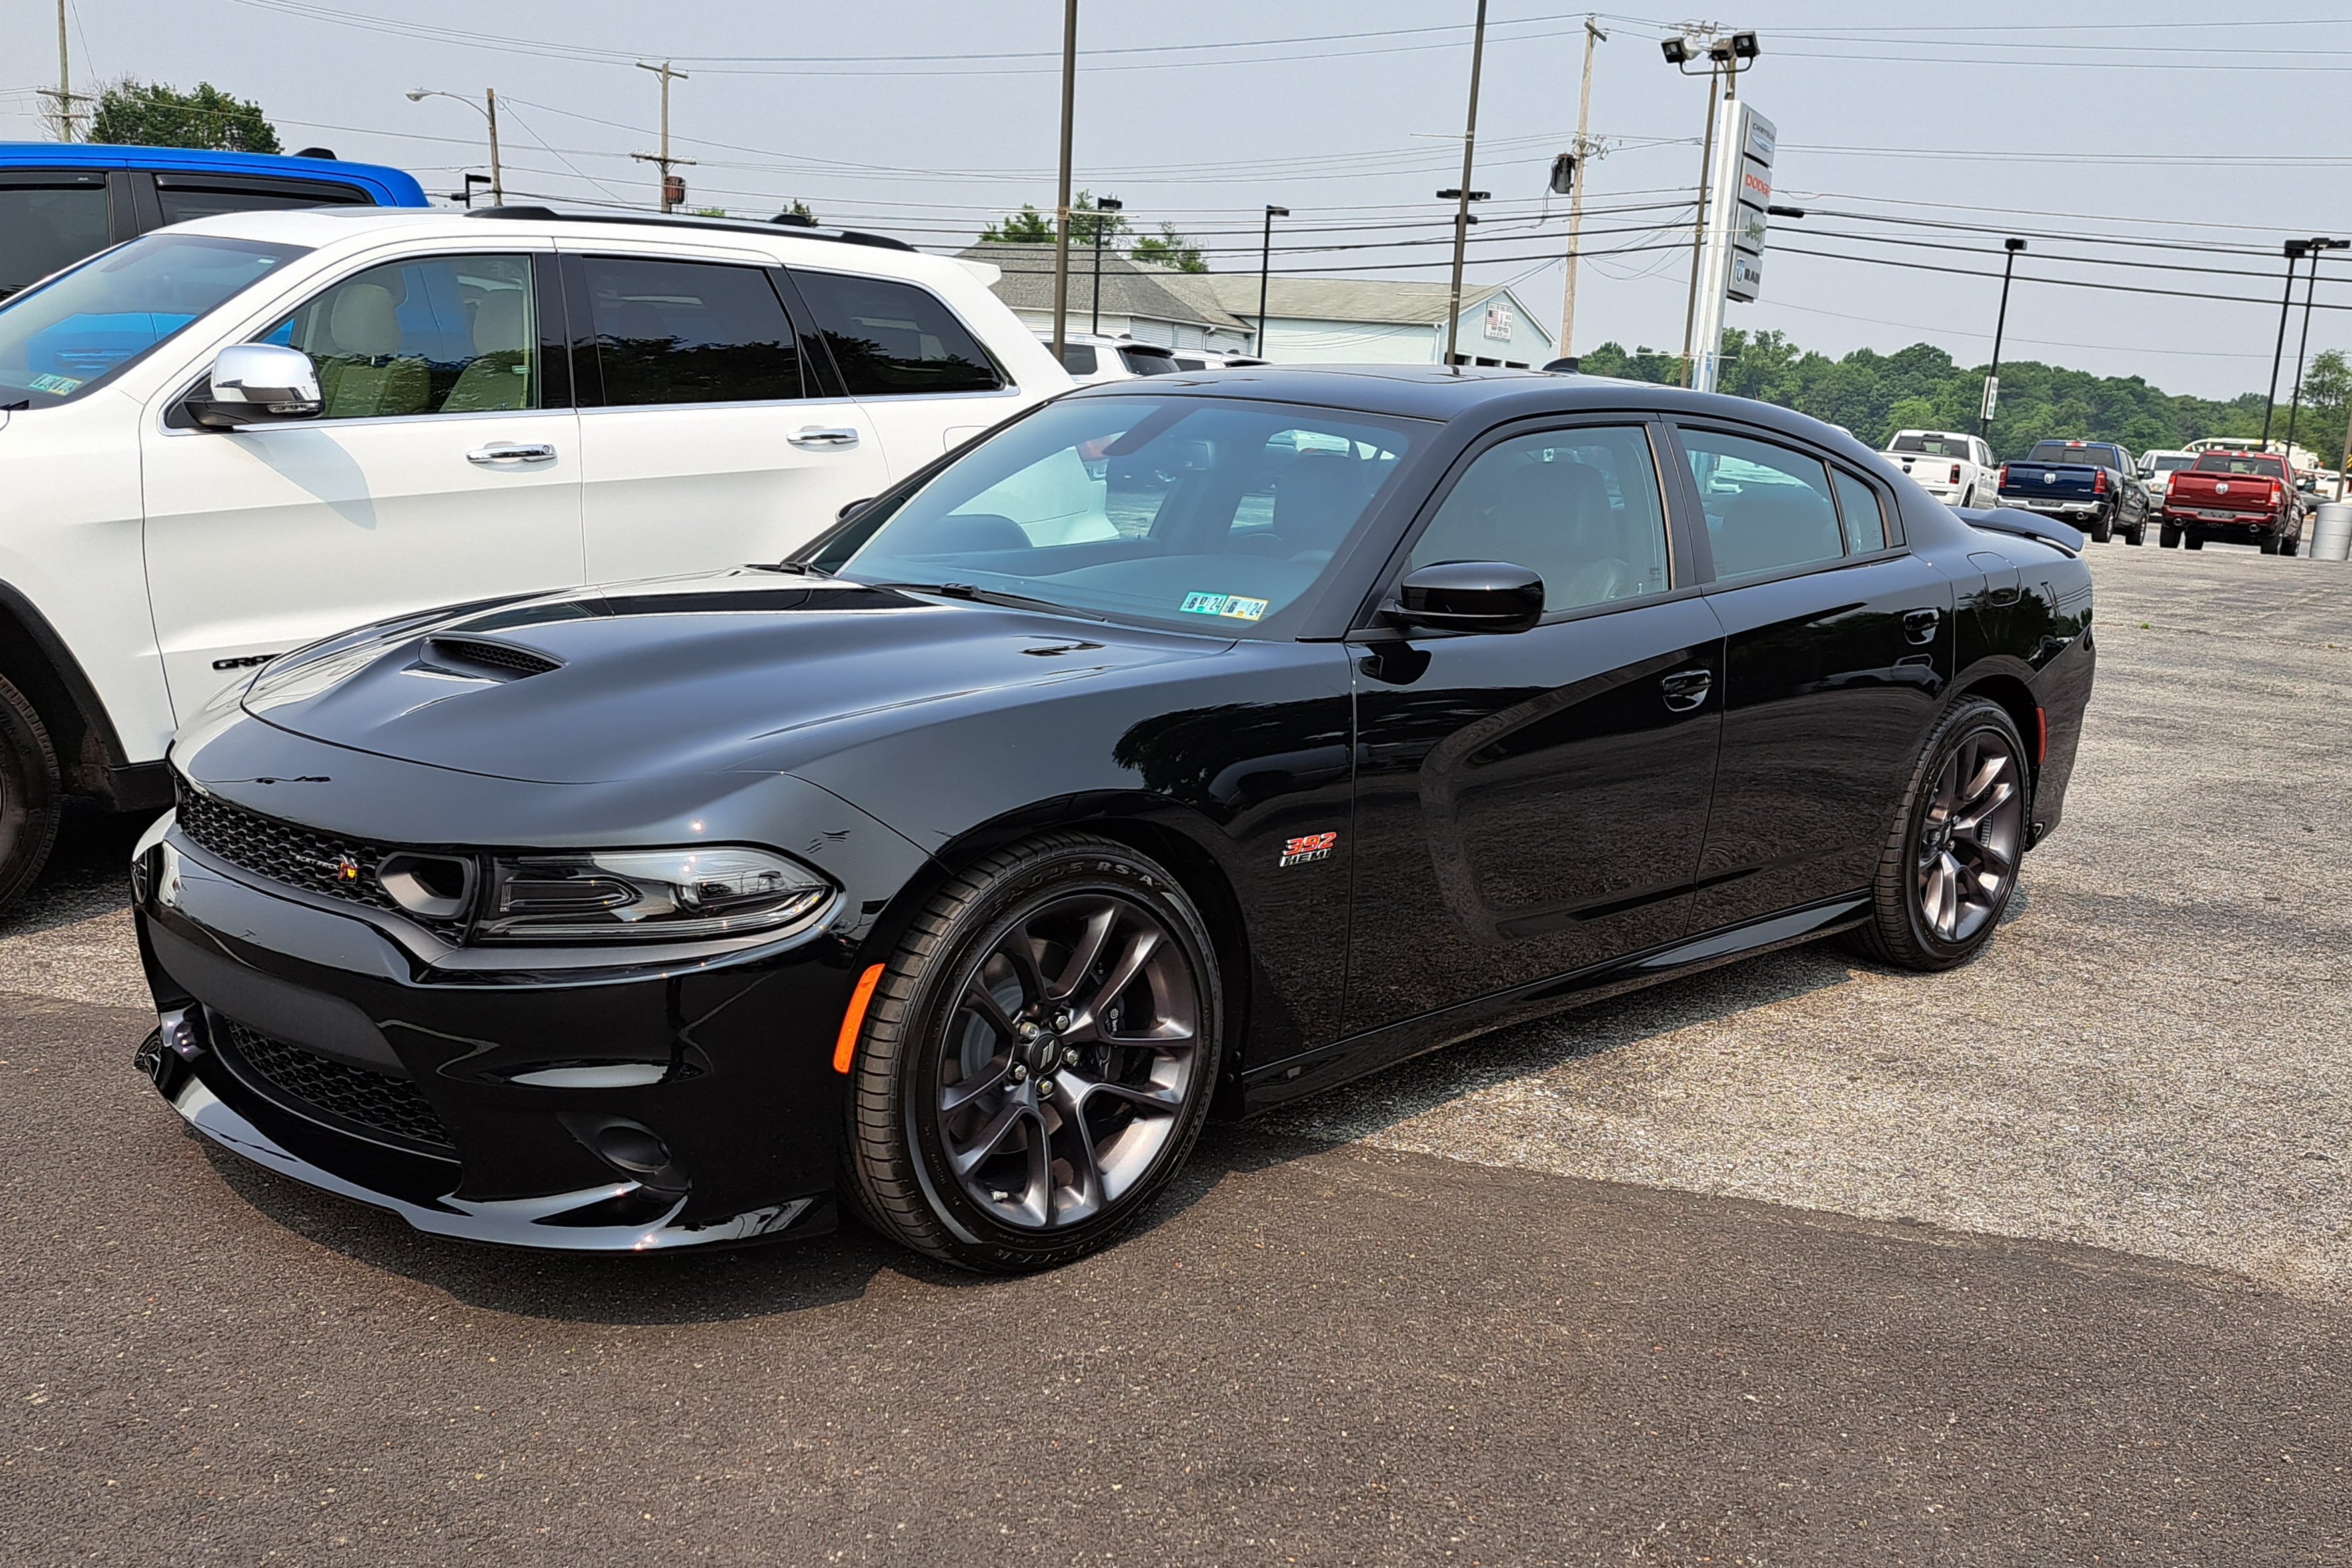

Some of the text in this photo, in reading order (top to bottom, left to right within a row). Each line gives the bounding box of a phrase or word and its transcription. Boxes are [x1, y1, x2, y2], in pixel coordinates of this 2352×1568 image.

[1746, 173, 1769, 197] DODGE
[1282, 832, 1337, 856] 392
[1279, 848, 1332, 868] HEMI
